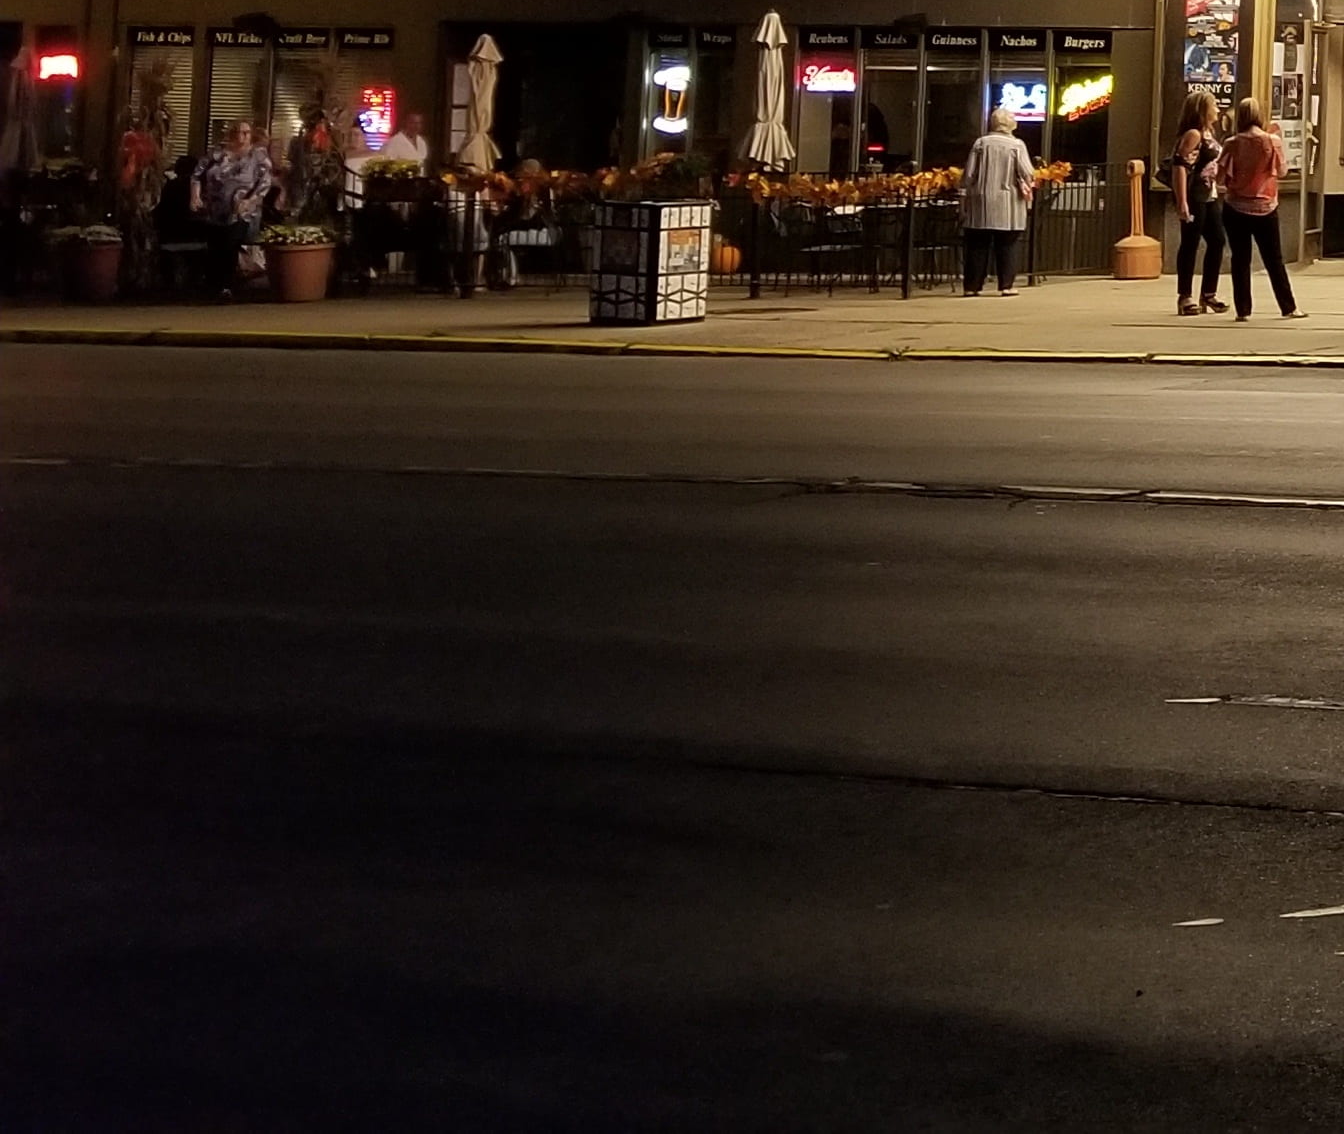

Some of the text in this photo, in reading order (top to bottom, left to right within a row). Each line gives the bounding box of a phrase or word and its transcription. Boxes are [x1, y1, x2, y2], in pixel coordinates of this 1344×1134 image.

[137, 31, 192, 44] Fish & Chips
[214, 32, 234, 43] NFL
[305, 33, 326, 44] Beer
[344, 34, 371, 44] Prime
[703, 33, 732, 44] Wraps
[809, 33, 848, 44] Reubens
[874, 33, 908, 44] Salads
[932, 33, 977, 45] Guinness
[1001, 35, 1037, 47] Nachos
[1064, 36, 1105, 49] Burgers
[1187, 83, 1232, 93] KENNY G
